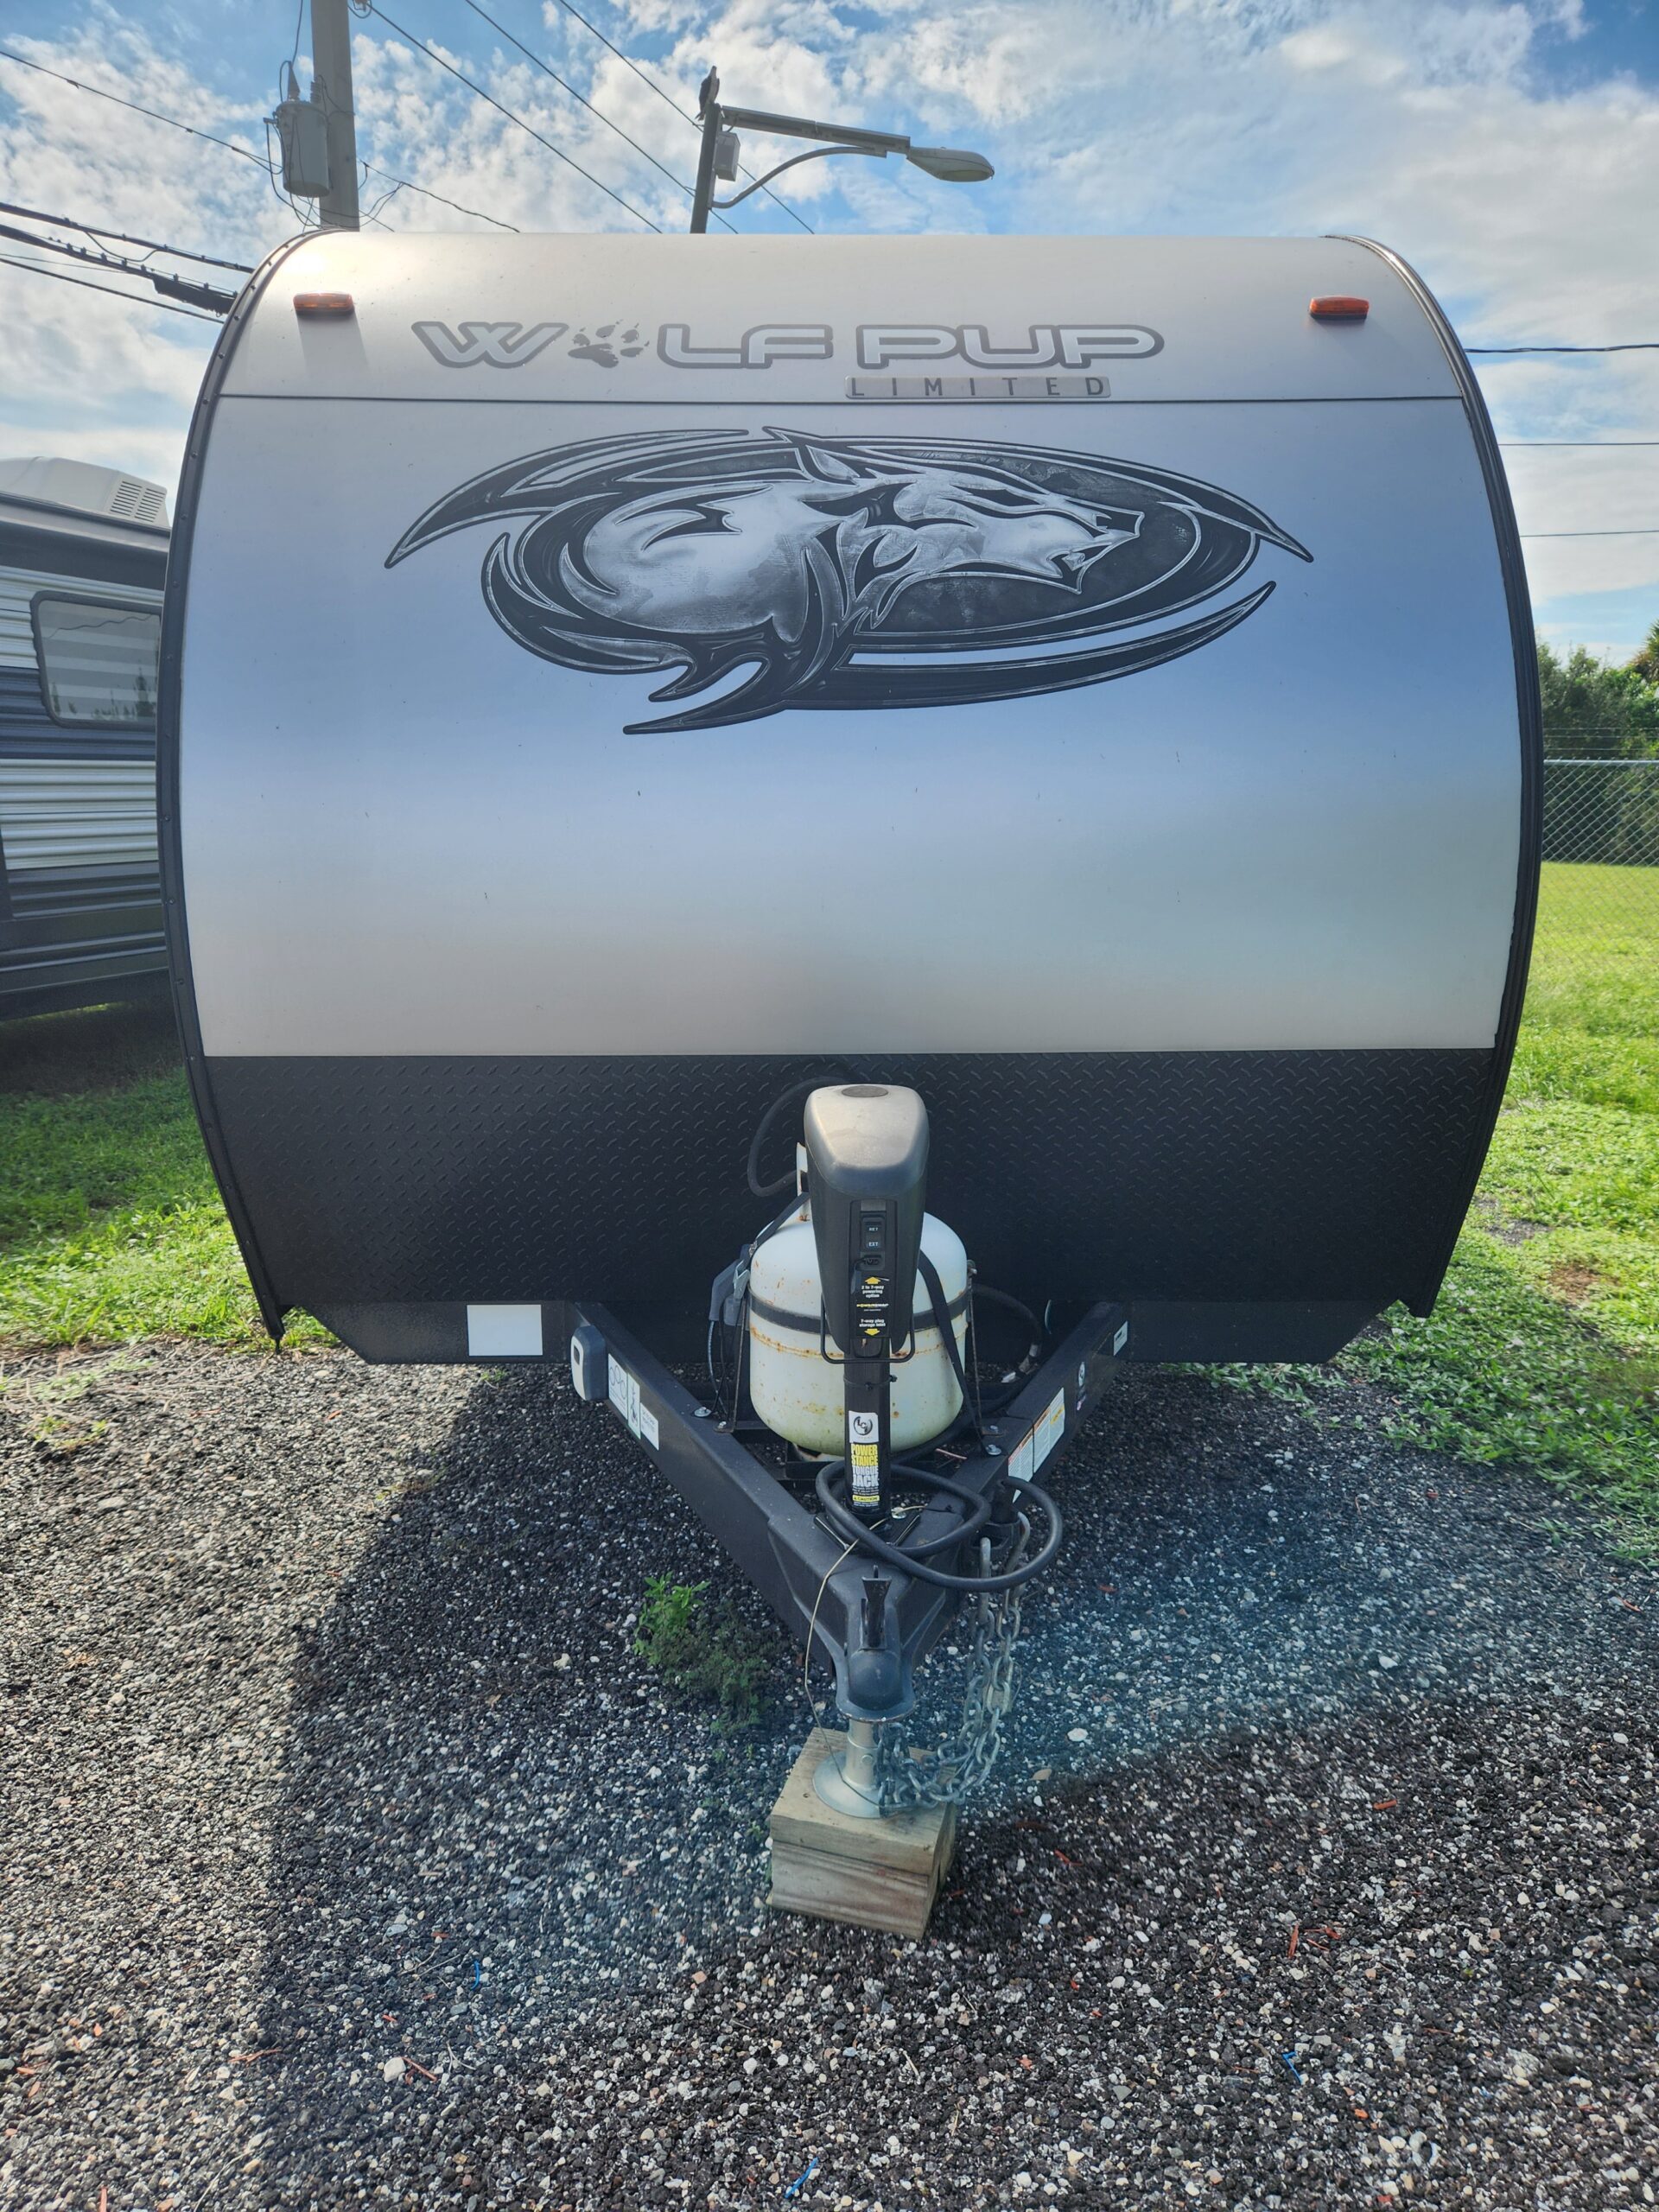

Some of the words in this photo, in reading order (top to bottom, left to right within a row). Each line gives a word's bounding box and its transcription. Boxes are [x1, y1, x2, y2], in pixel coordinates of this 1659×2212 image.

[855, 324, 1165, 370] PUP
[850, 376, 1103, 398] LIMITED
[851, 1443, 877, 1455] POWER
[851, 1455, 878, 1466] STANCE
[852, 1465, 879, 1476] TONGUE
[852, 1475, 879, 1487] JACK
